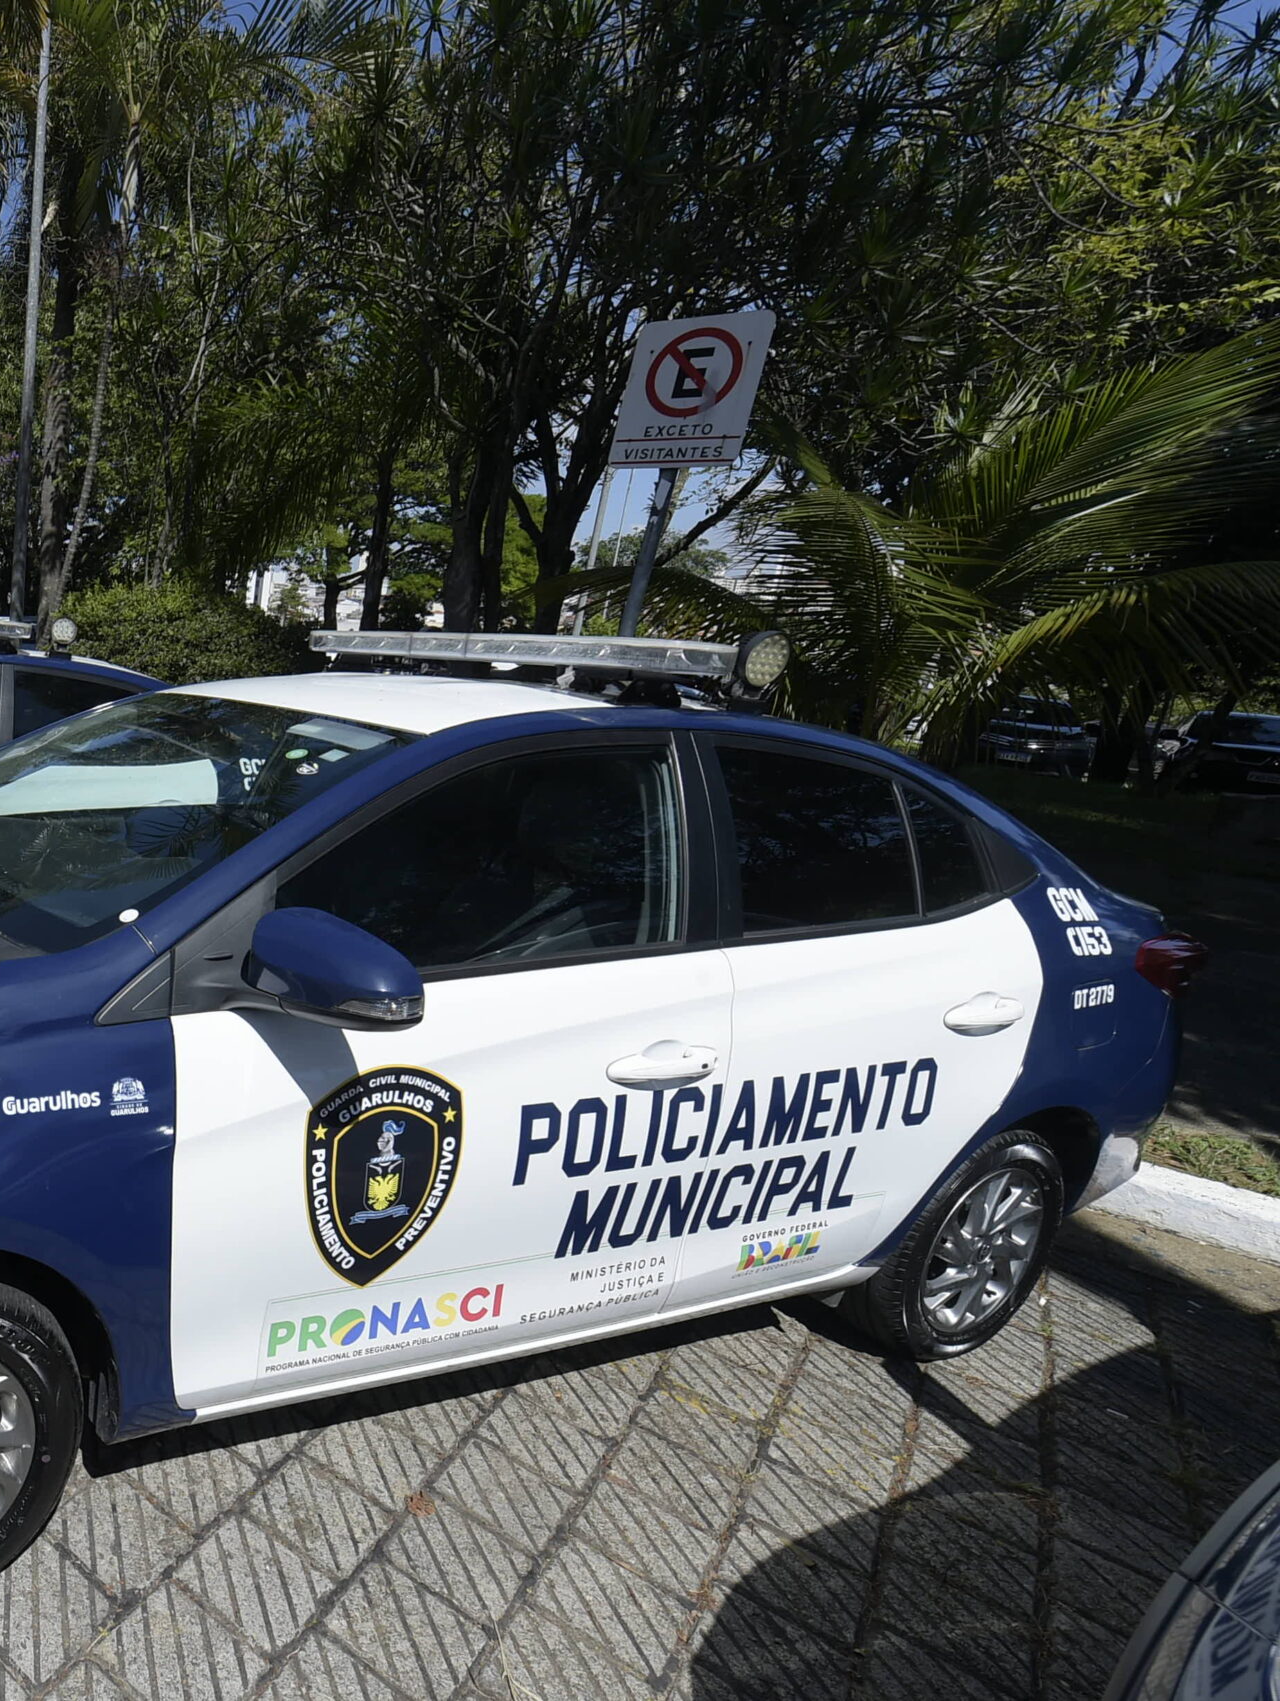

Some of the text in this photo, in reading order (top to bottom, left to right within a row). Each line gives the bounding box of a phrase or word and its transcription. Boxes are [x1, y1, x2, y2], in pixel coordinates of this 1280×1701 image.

[643, 423, 713, 438] EXCETO
[623, 446, 724, 460] VISITANTES
[239, 758, 266, 775] GC
[1046, 887, 1099, 922] GCM
[1073, 984, 1115, 1010] DT 2779
[2, 1090, 101, 1116] Guarulhos
[320, 1074, 450, 1119] GUARDA CIVIL MUNICIPAL
[338, 1090, 434, 1124] GUARULHOS
[512, 1057, 939, 1187] POLICIAMENTO
[312, 1148, 356, 1270] POLICIAMENTO
[395, 1136, 456, 1251] PREVENTIVO
[554, 1146, 857, 1259] MUNICIPAL
[742, 1219, 829, 1243] GOVERNO FEDERAL
[570, 1255, 666, 1282] MINISTÉRIO DA
[600, 1272, 664, 1294] JUSTIÇA E
[267, 1283, 504, 1358] PRONASCI
[520, 1288, 659, 1324] SEGURANÇA PÚBLICA
[265, 1325, 499, 1373] PROGRAMA NACIONAL DE SEGURANÇA PÚBLICA COM CIDADANIA
